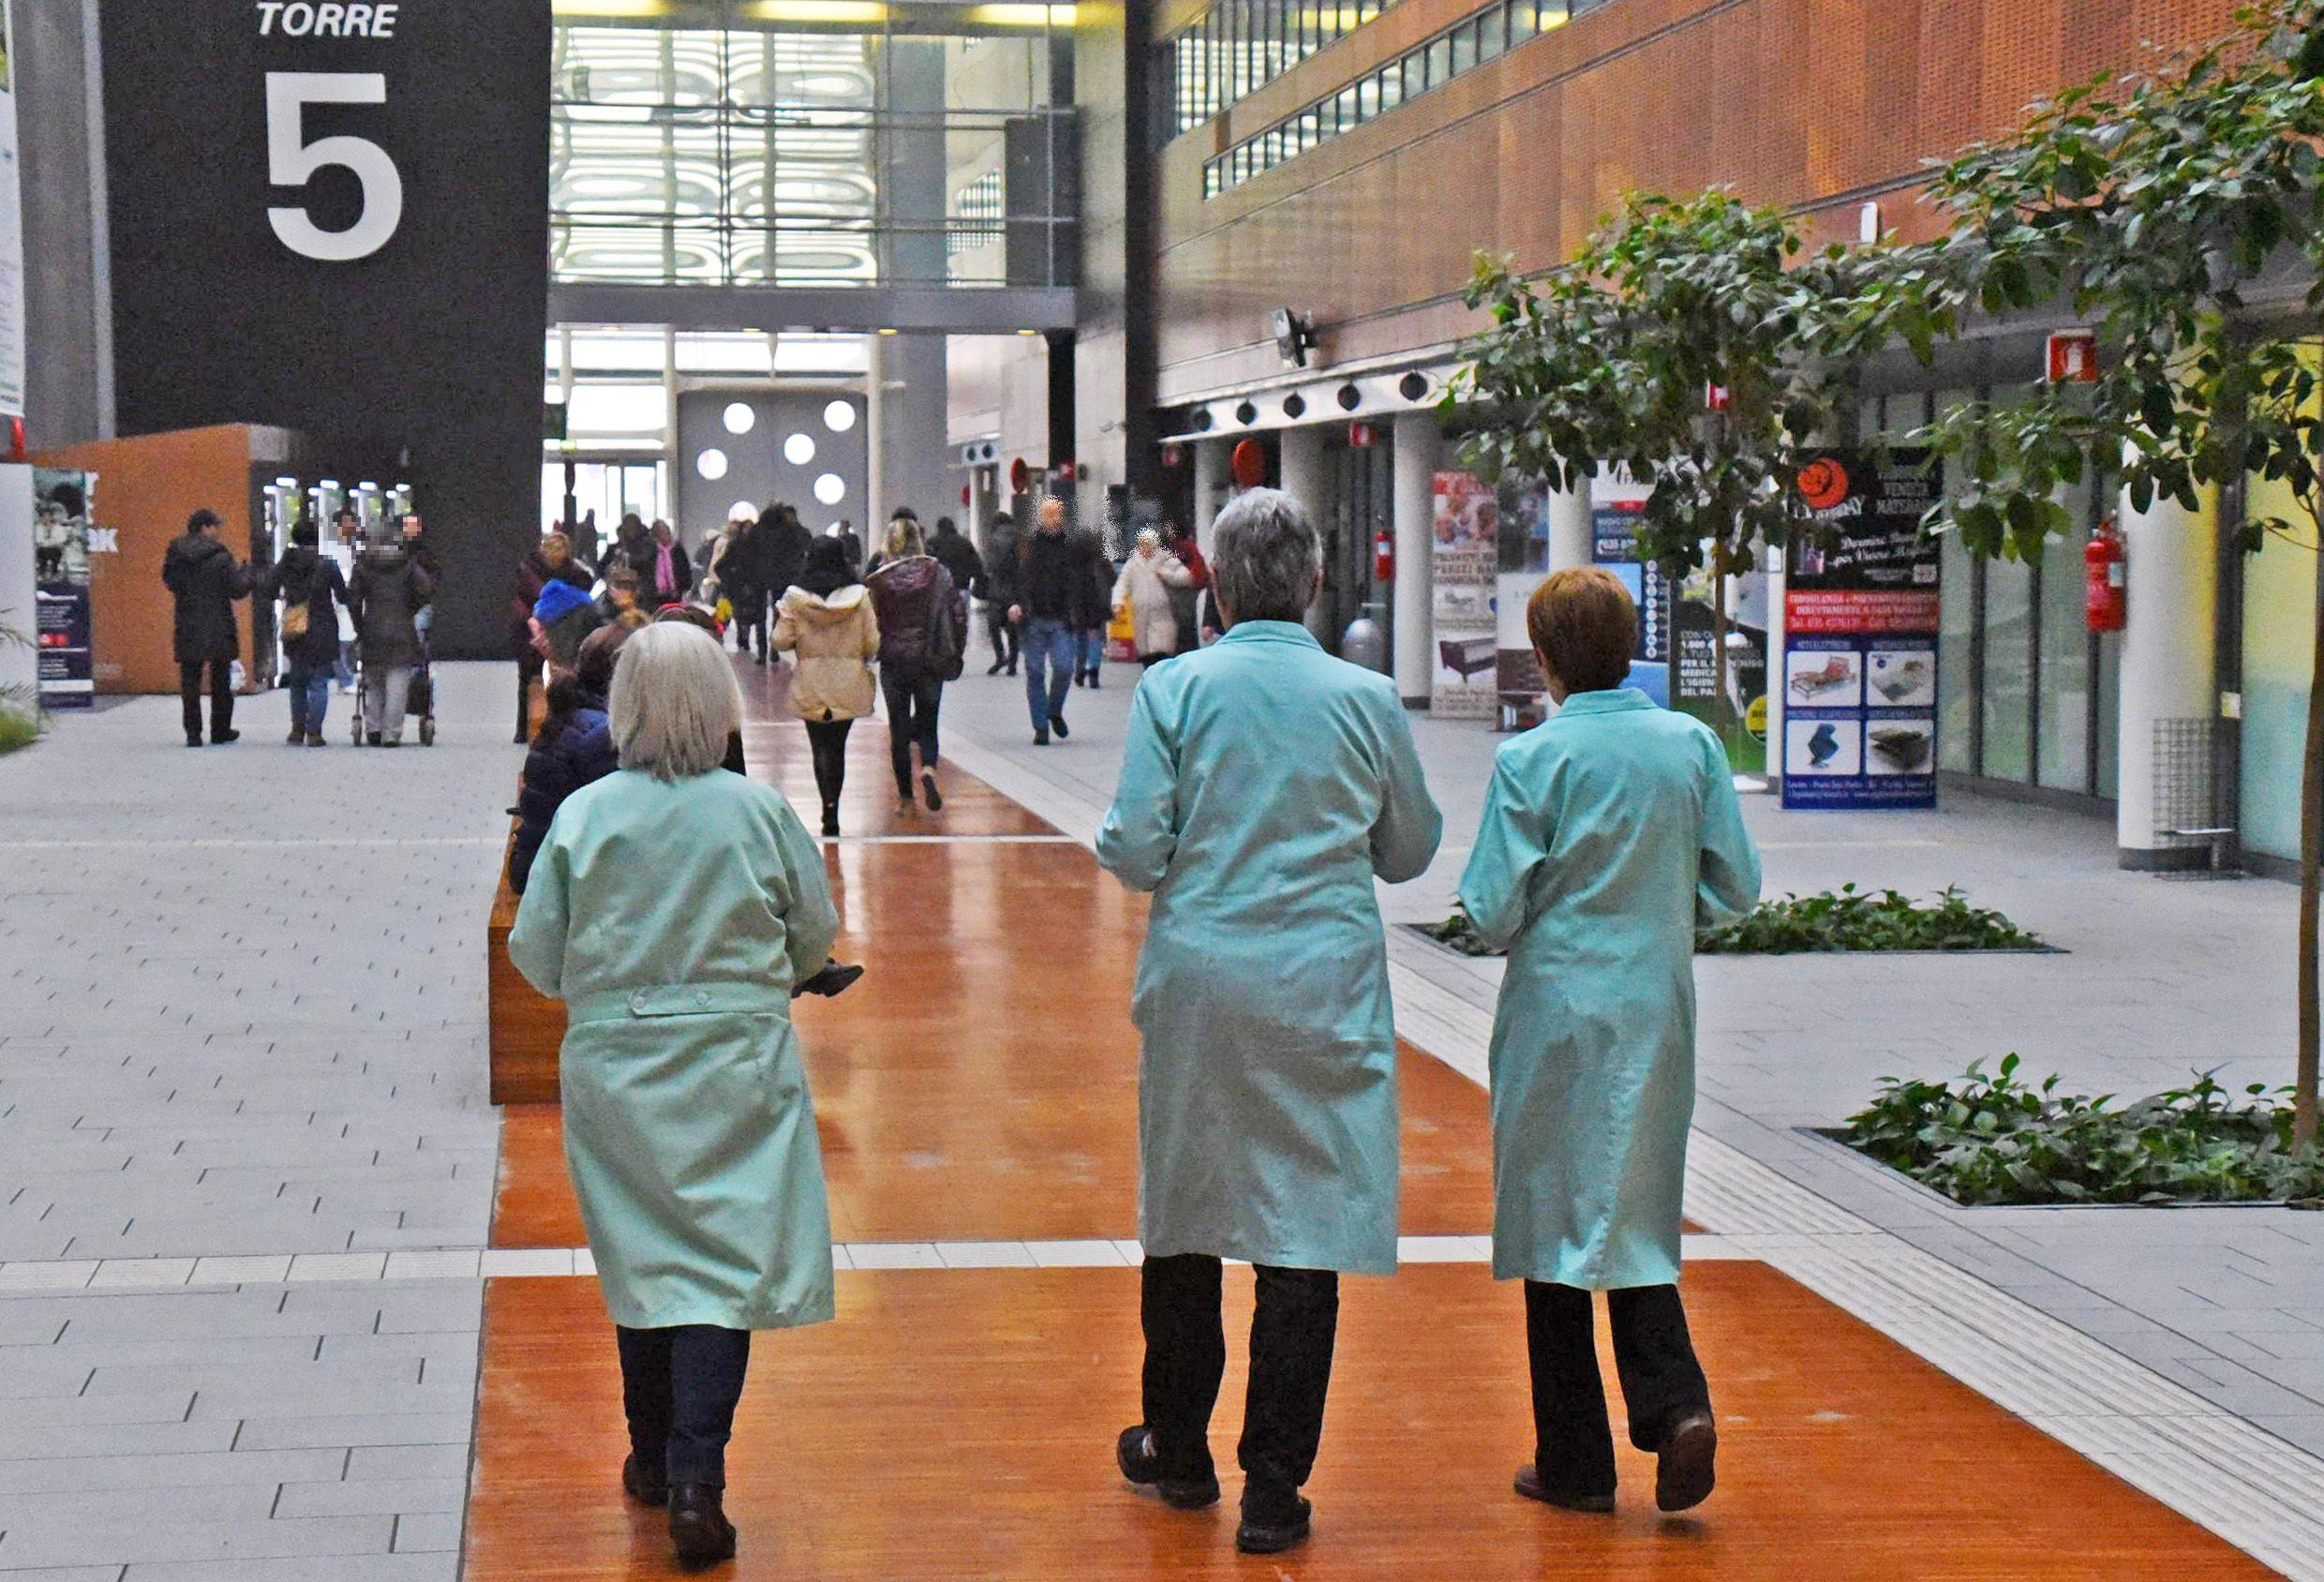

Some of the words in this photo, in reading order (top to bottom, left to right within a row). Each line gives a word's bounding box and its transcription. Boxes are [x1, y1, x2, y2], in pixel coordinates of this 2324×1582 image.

[257, 2, 398, 37] TORRE
[265, 72, 403, 261] 5
[1680, 659, 1697, 667] PER
[1680, 668, 1717, 677] MEDICA
